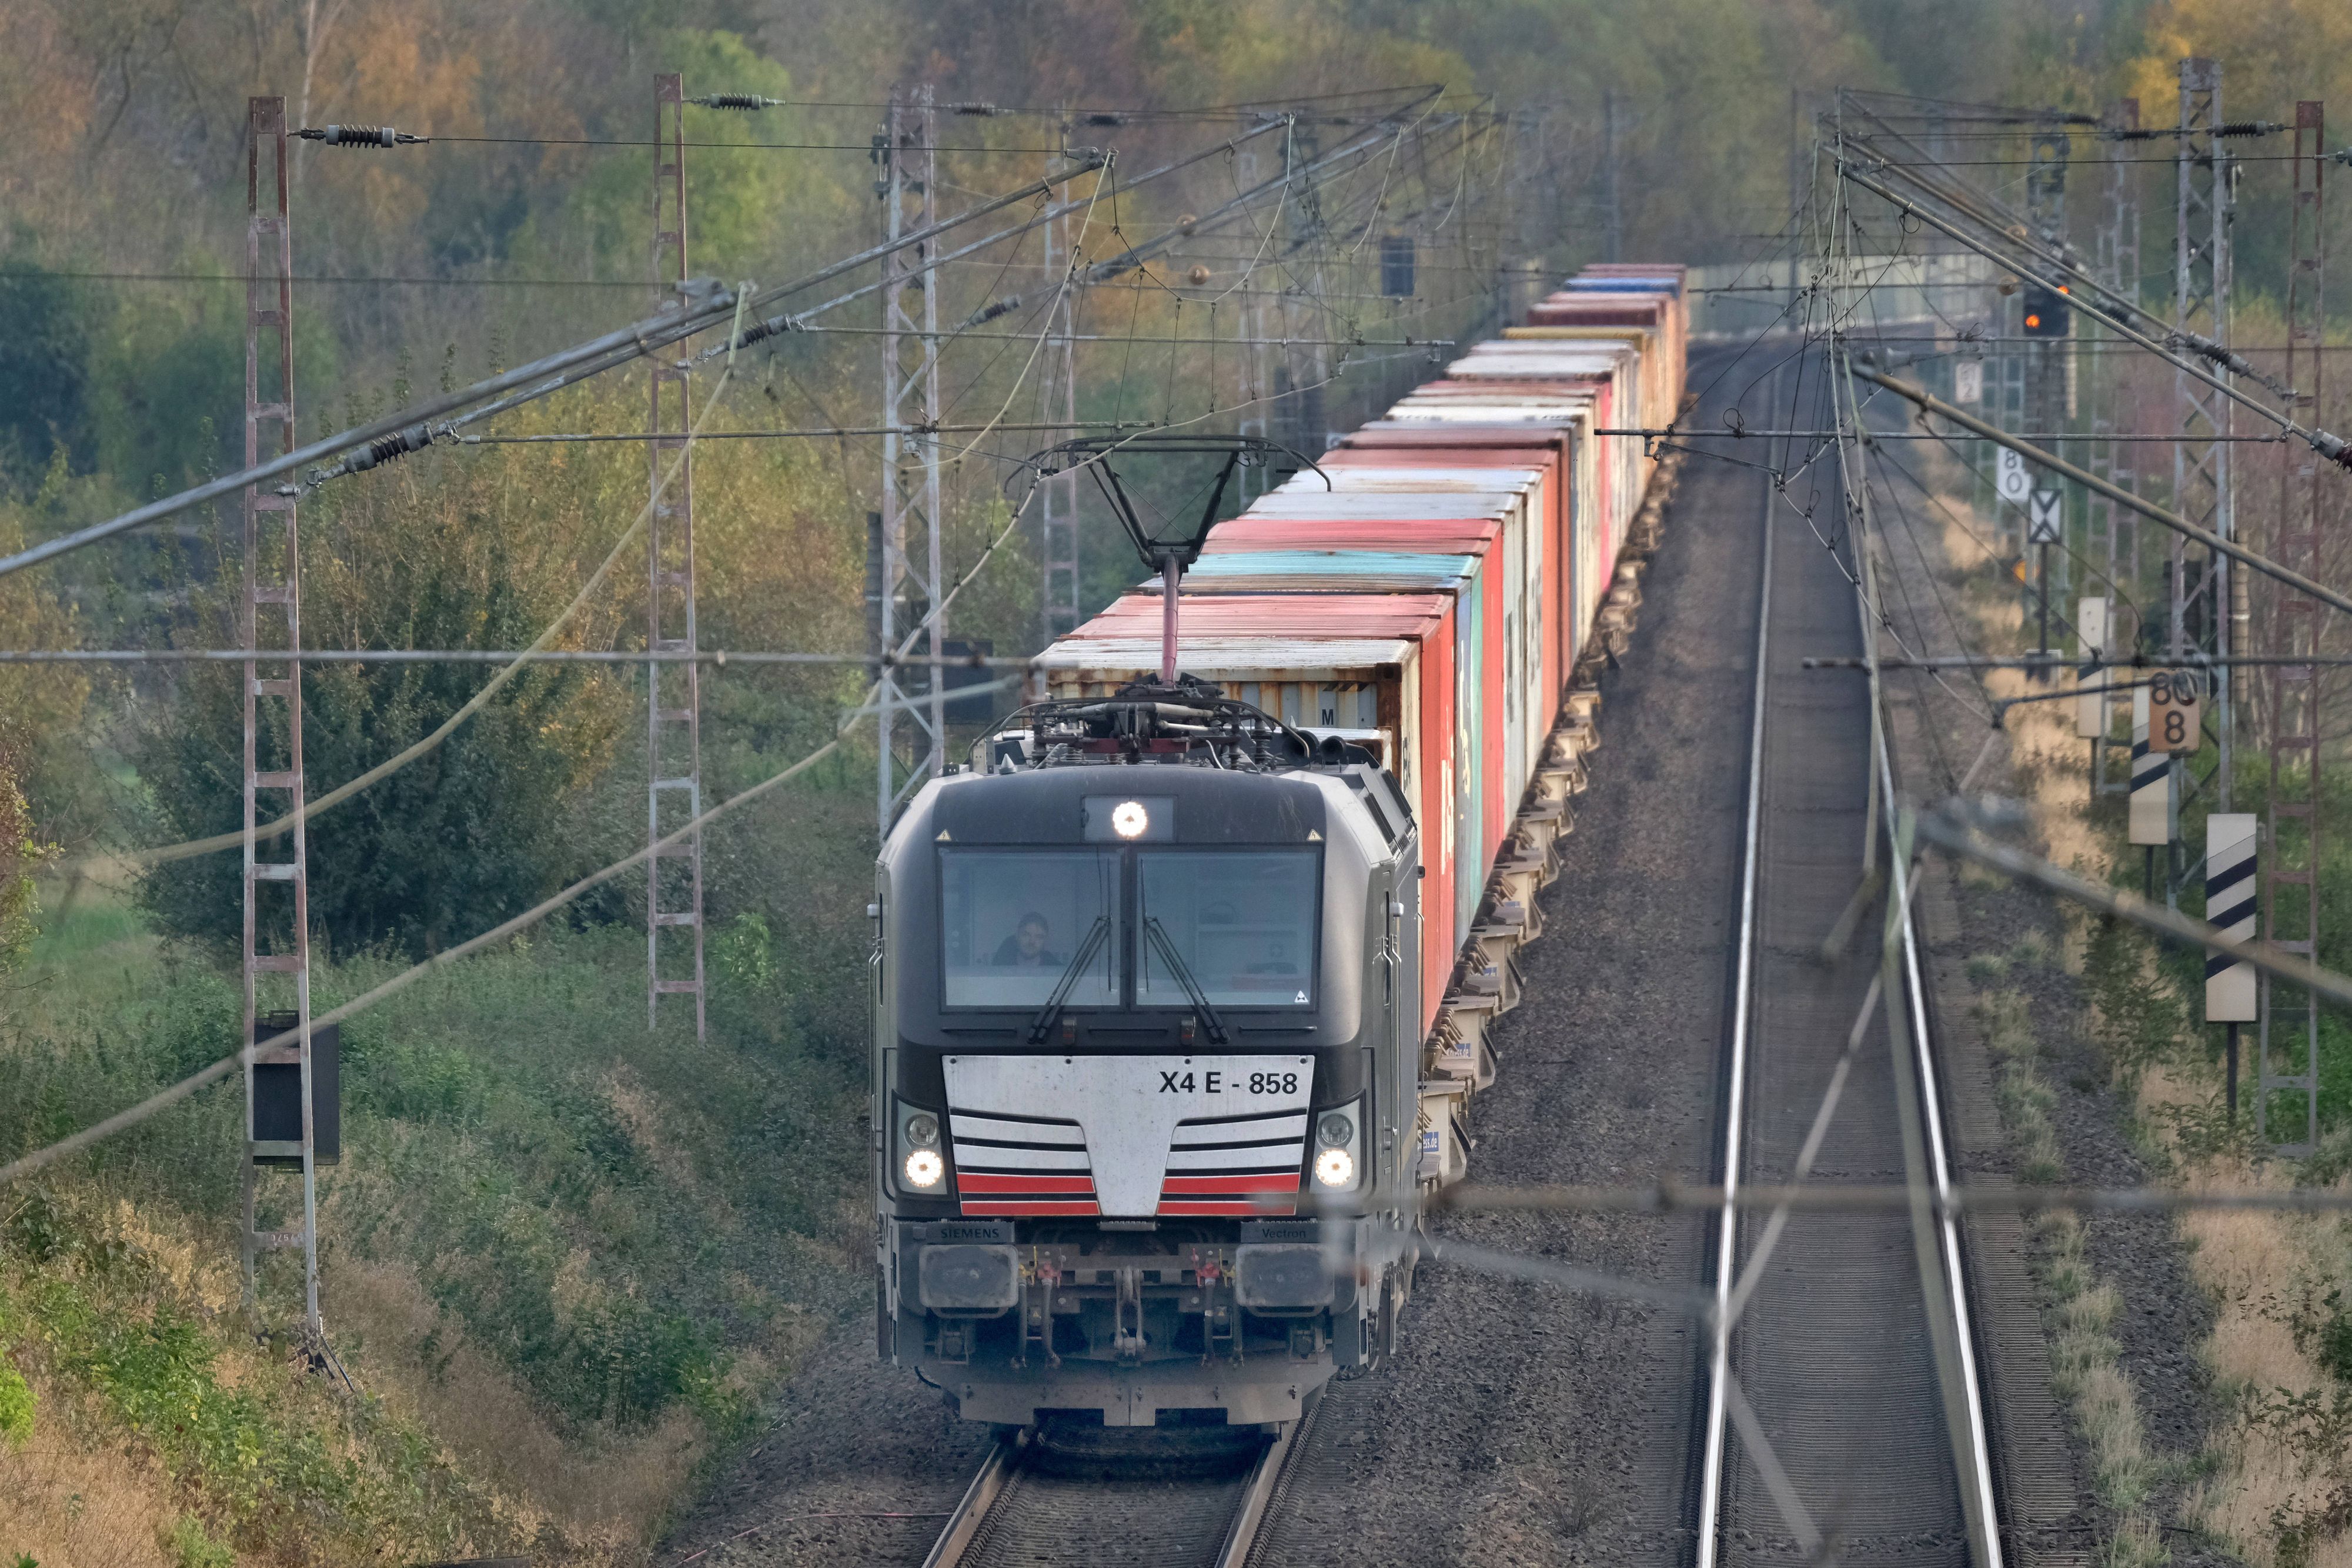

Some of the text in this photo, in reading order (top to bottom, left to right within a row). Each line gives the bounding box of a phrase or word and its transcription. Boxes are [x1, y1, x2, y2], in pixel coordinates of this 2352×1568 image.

[2150, 671, 2198, 706] 80
[1322, 709, 1334, 726] M
[2164, 710, 2186, 744] 8
[1158, 1071, 1196, 1093] X4
[1205, 1071, 1221, 1093] E
[1249, 1072, 1297, 1094] 858
[941, 1228, 999, 1238] SIEMENS
[1262, 1228, 1306, 1238] Vectron
